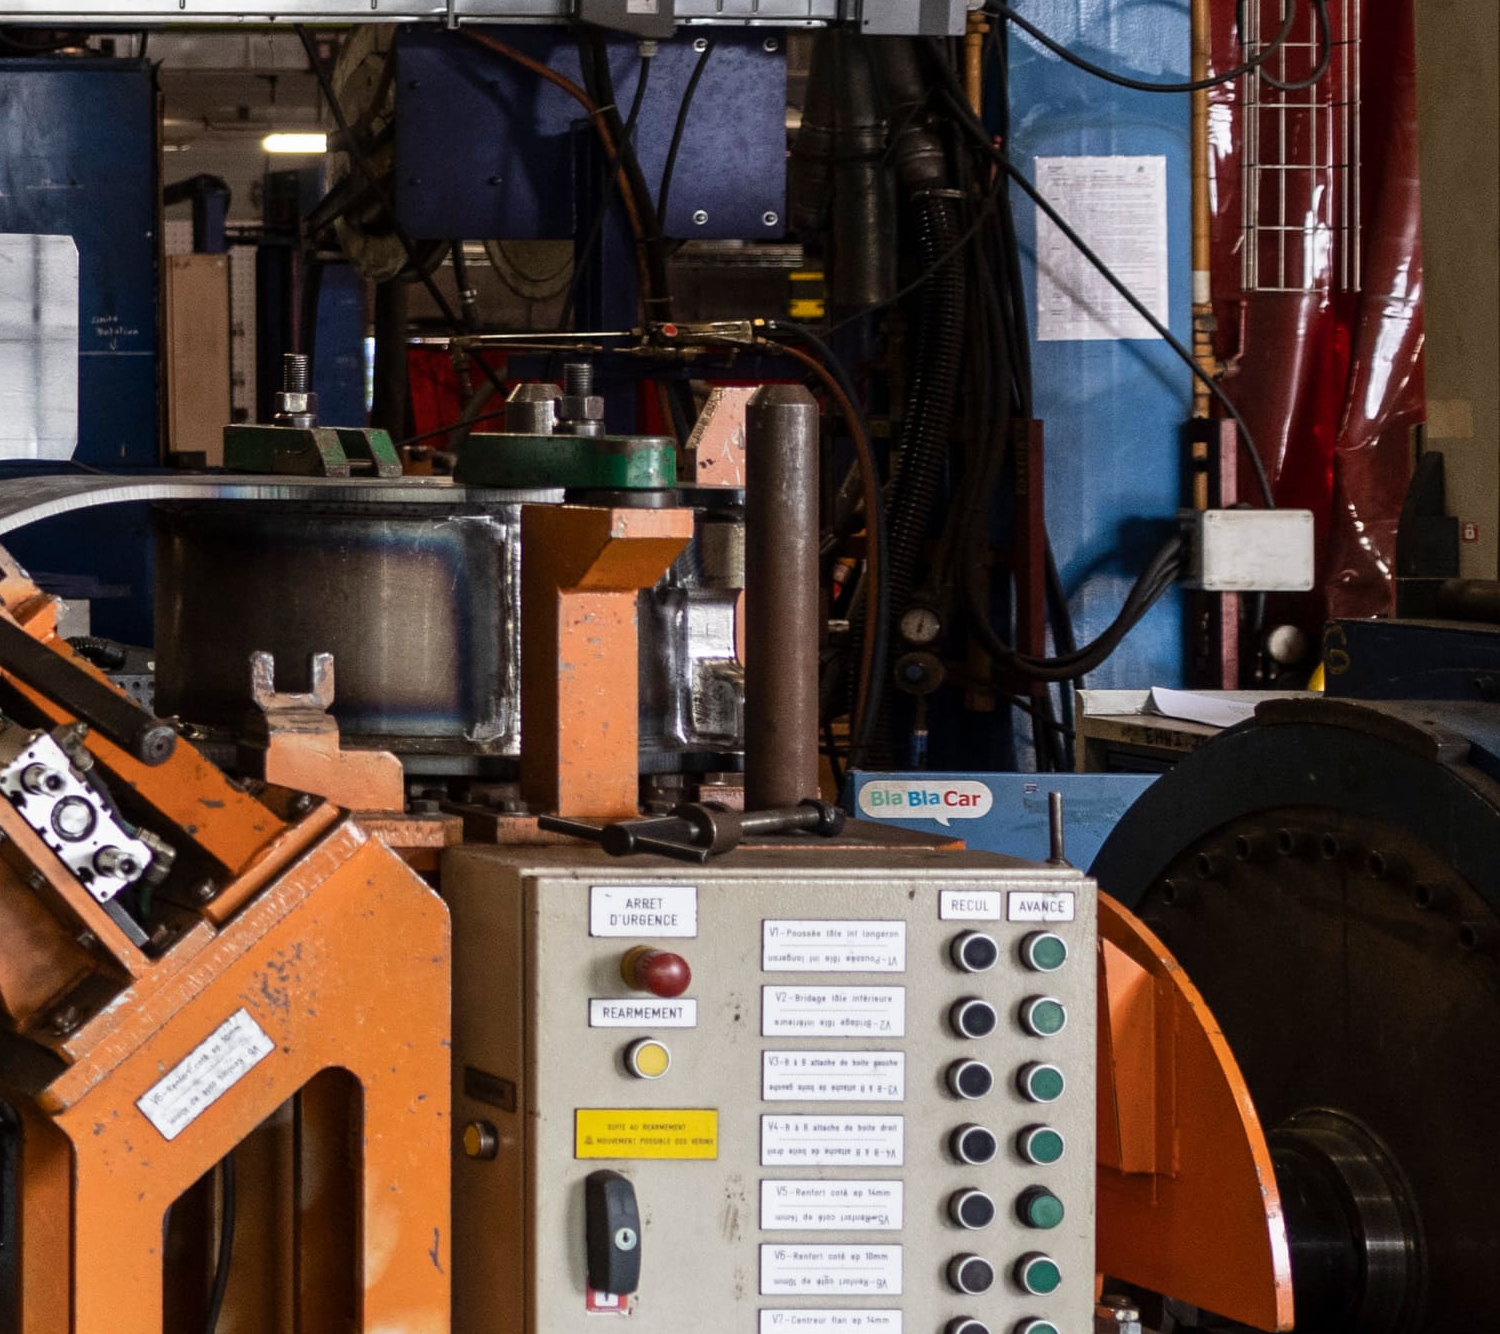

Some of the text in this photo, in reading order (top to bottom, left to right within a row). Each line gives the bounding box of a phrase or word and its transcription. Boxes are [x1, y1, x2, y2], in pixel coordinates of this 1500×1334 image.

[625, 898, 663, 910] ARRET
[951, 899, 989, 912] RECUL
[1019, 899, 1064, 913] AVANCE
[610, 914, 677, 926] D'URGENCE
[862, 930, 899, 940] longeron
[603, 1007, 683, 1019] REARMEMENT
[844, 1124, 853, 1132] de
[853, 1190, 863, 1198] ep
[850, 1254, 861, 1262] ep
[852, 1317, 862, 1326] ep
